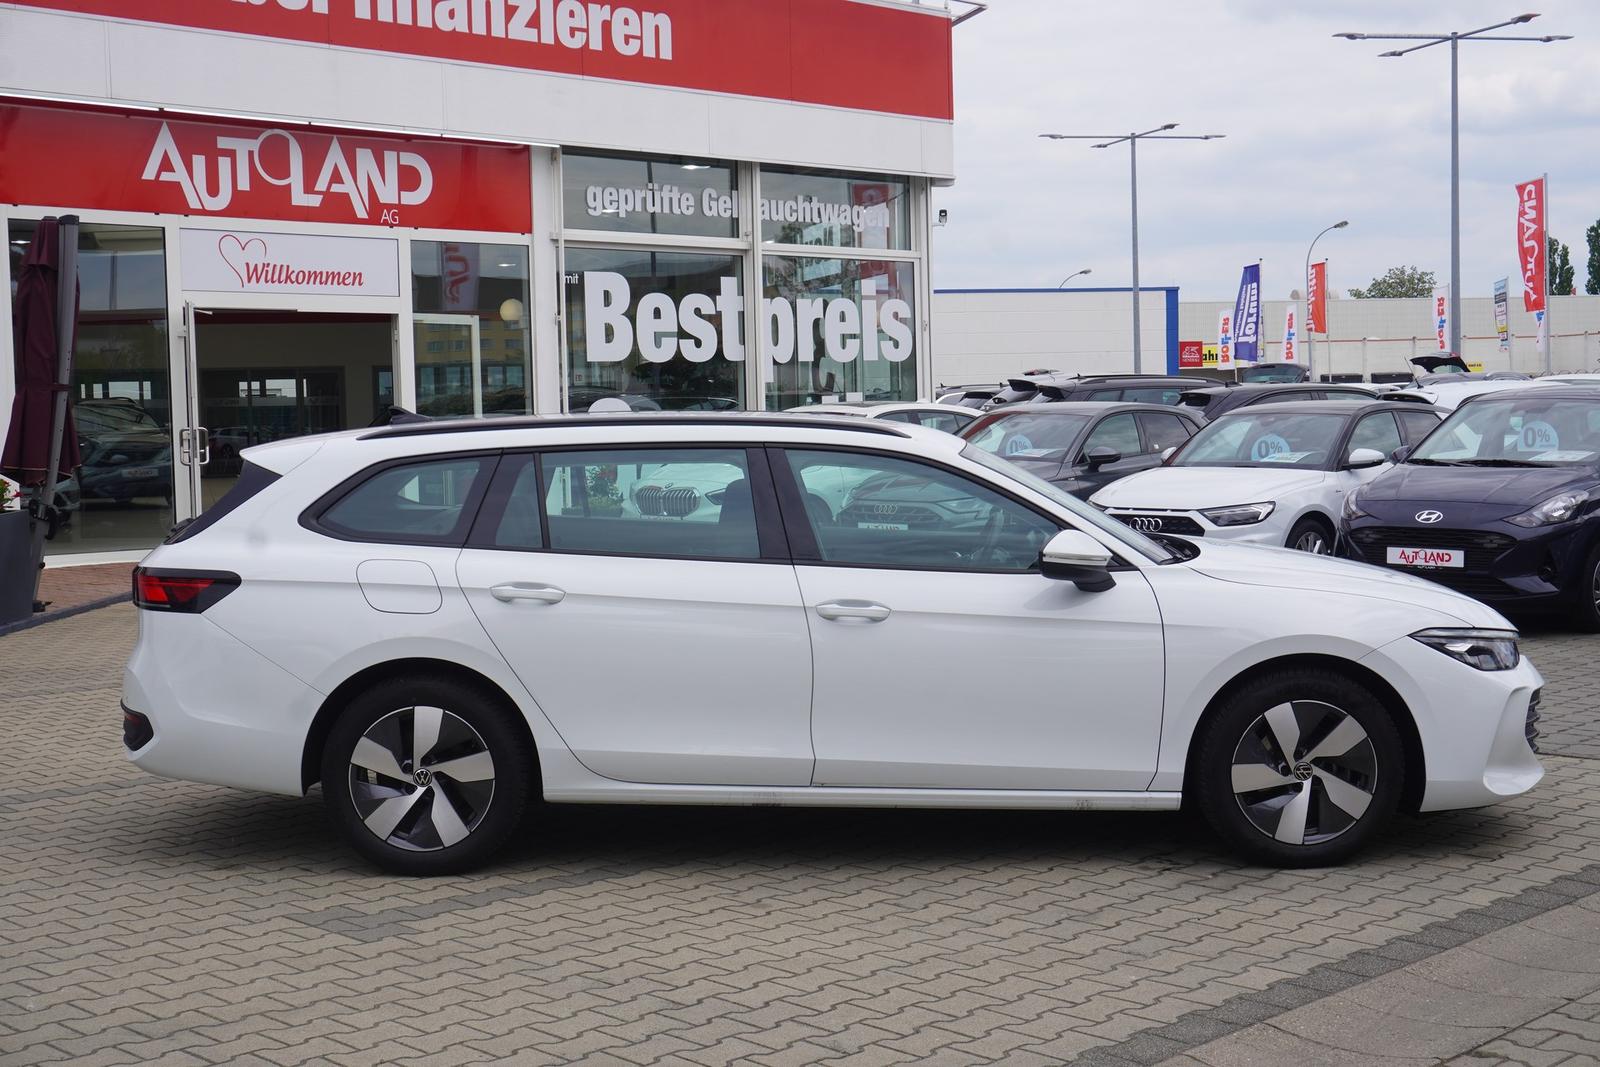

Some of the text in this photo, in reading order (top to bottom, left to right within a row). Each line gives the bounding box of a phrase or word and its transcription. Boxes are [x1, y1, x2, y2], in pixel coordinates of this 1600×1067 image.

[354, 0, 672, 60] nanzieren
[141, 120, 433, 219] AUTOLAND
[380, 209, 399, 224] AG
[586, 183, 890, 233] geprüfte Geauchtwagen
[244, 262, 364, 286] Willkommen
[563, 273, 579, 285] mit
[1522, 427, 1551, 448] 0%
[1257, 440, 1283, 459] 0%
[1399, 549, 1452, 566] AUTOLAND
